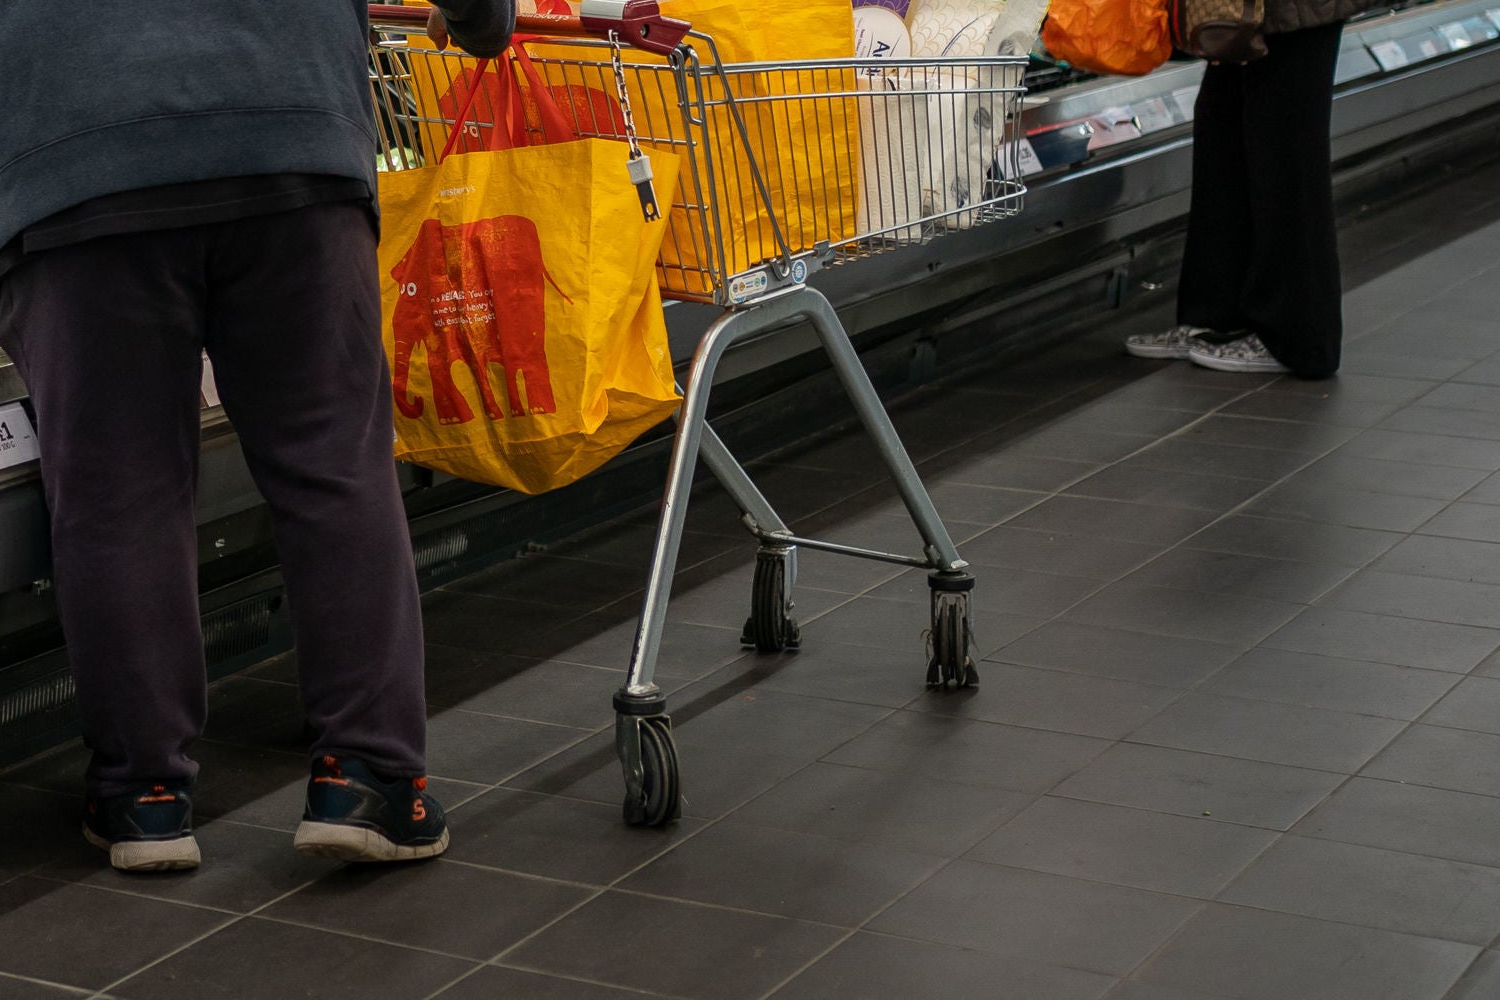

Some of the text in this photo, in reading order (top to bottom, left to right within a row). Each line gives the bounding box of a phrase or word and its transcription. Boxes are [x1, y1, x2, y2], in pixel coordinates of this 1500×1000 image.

[468, 290, 483, 299] You
[474, 312, 496, 324] forget
[1, 442, 11, 452] 100
[412, 799, 426, 821] S
